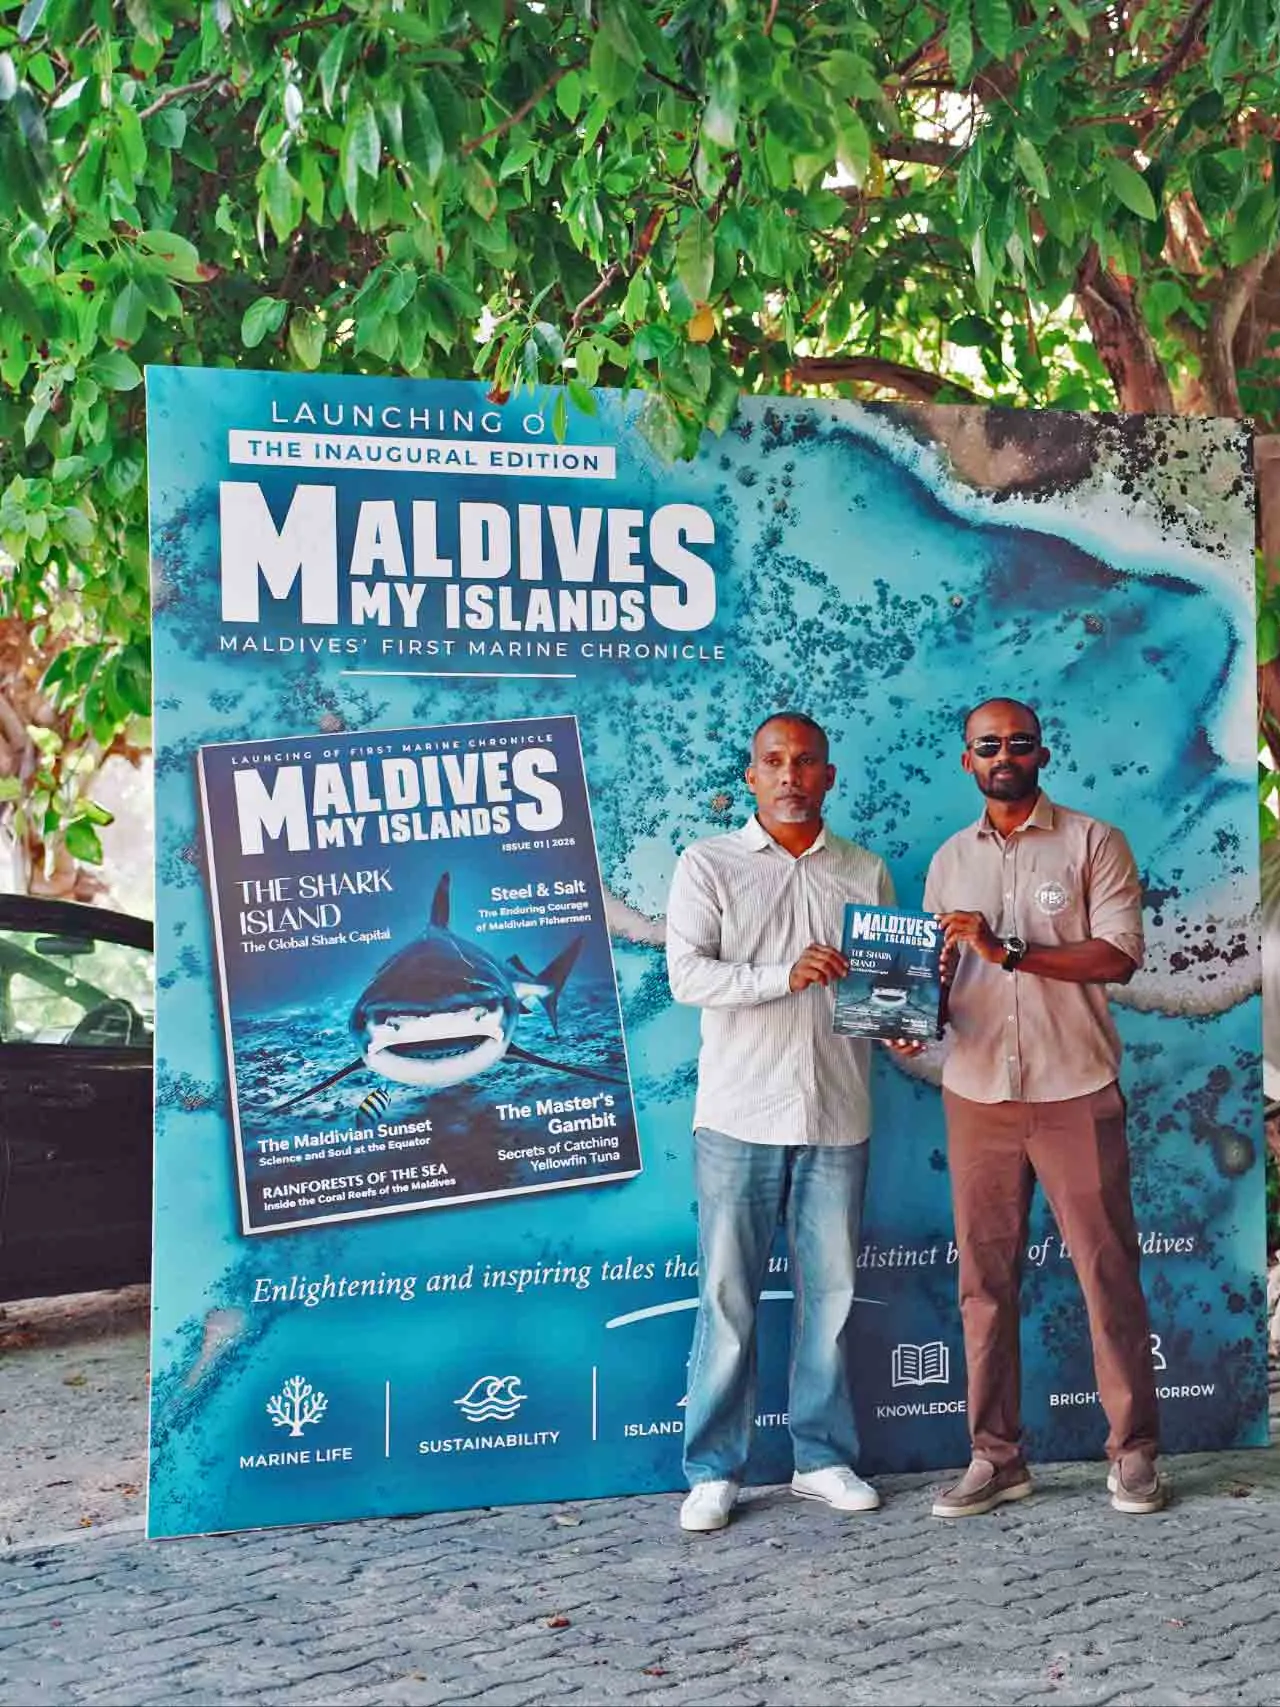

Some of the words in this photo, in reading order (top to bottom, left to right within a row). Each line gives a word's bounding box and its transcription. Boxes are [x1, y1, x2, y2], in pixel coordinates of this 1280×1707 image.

[271, 401, 502, 434] LAUNCHING
[248, 439, 302, 459] THE
[315, 442, 478, 468] INAUGURAL
[489, 450, 599, 471] EDITION
[219, 480, 717, 632] MALDIVES
[352, 582, 427, 628] MY
[447, 584, 648, 633] ISLANDS
[382, 640, 455, 657] FIRST
[469, 641, 568, 658] MARINE
[581, 643, 726, 661] CHRONICLE
[323, 750, 340, 758] OF
[350, 746, 393, 756] FIRST
[402, 741, 460, 752] MARINE
[468, 734, 553, 748] CHRONICLE
[233, 748, 564, 856] MALDIVES
[315, 817, 366, 849] MY
[379, 805, 511, 844] ISLANDS
[502, 842, 531, 852] ISSUE
[533, 840, 544, 849] 01
[234, 877, 294, 905] THE
[298, 864, 394, 899] SHARK
[491, 883, 532, 901] Steel
[536, 883, 549, 897] &
[554, 879, 586, 896] Salt
[239, 904, 342, 935] ISLAND
[479, 908, 498, 918] The
[500, 904, 546, 917] Enduring
[547, 901, 589, 912] Courage
[241, 942, 266, 953] The
[268, 935, 309, 951] Global
[311, 932, 347, 946] Shark
[349, 926, 392, 945] Capital
[476, 922, 487, 933] of
[489, 919, 537, 931] Maldivian
[852, 911, 937, 948] MALDIVES
[495, 1103, 532, 1121] The
[535, 1091, 615, 1116] Master's
[257, 1139, 289, 1154] The
[294, 1127, 374, 1149] Maldivian
[377, 1119, 433, 1138] Sunset
[548, 1112, 617, 1135] Gambit
[259, 1154, 304, 1167] Science
[305, 1149, 326, 1161] and
[328, 1145, 352, 1158] Soul
[355, 1146, 366, 1155] at
[368, 1142, 386, 1152] the
[388, 1136, 431, 1150] Equator
[497, 1145, 546, 1161] Secrets
[548, 1143, 561, 1155] of
[564, 1136, 619, 1152] Catching
[530, 1155, 587, 1172] Yellowfin
[589, 1151, 621, 1164] Tuna
[263, 1174, 364, 1199] RAINFORESTS
[367, 1171, 387, 1185] OF
[390, 1166, 418, 1181] THE
[421, 1162, 449, 1177] SEA
[264, 1200, 297, 1212] Inside
[298, 1195, 316, 1206] the
[318, 1191, 346, 1204] Coral
[379, 1184, 390, 1195] of
[392, 1183, 409, 1193] the
[411, 1178, 457, 1190] Maldives
[251, 1272, 417, 1307] Enlightening
[426, 1265, 474, 1292] and
[482, 1260, 593, 1293] inspiring
[600, 1257, 655, 1281] tales
[664, 1254, 700, 1279] tha
[856, 1244, 937, 1269] distinct
[1027, 1236, 1054, 1266] of
[877, 1400, 967, 1418] KNOWLEDGE
[418, 1430, 560, 1454] SUSTAINABILITY
[624, 1420, 684, 1437] ISLAND
[239, 1449, 310, 1469] MARINE
[315, 1447, 353, 1462] LIFE
